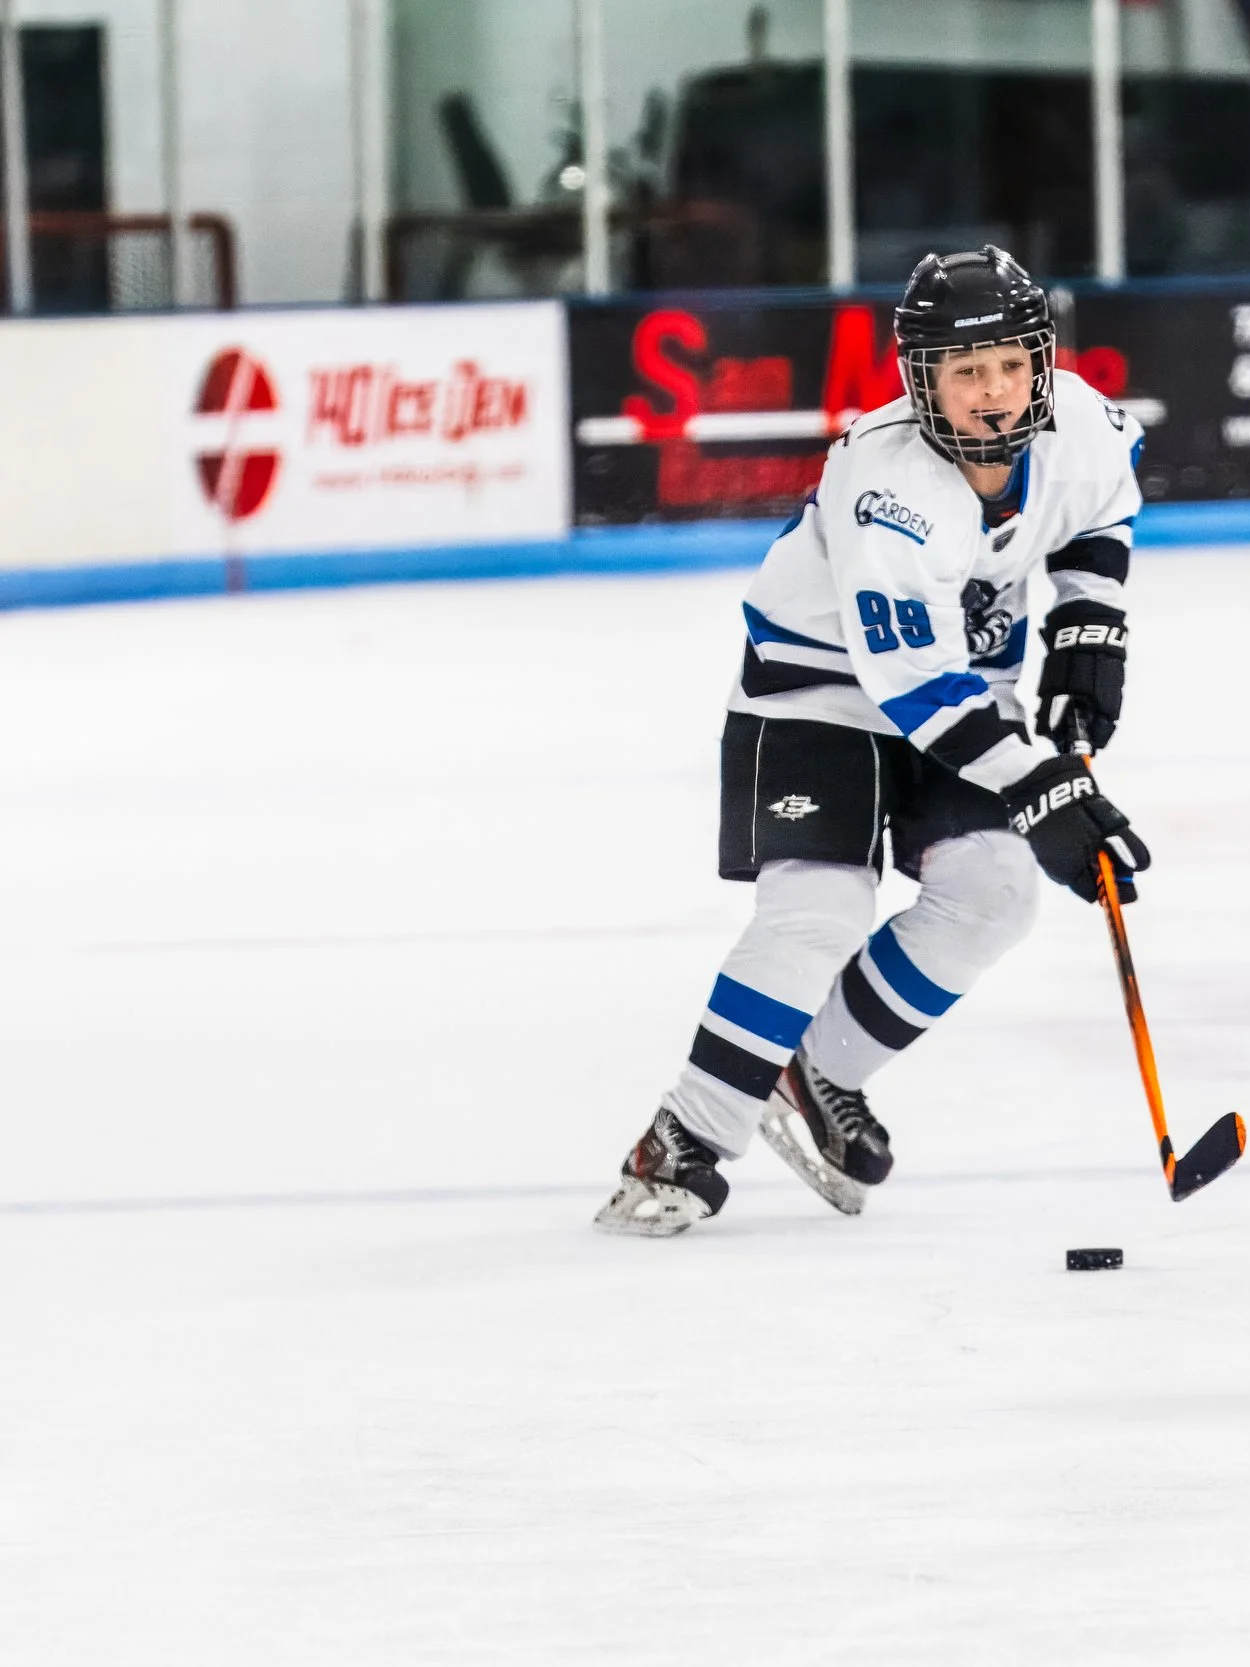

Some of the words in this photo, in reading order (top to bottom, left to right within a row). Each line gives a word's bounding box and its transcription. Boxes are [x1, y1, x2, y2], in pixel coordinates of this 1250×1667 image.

[856, 590, 936, 654] 99
[1054, 624, 1126, 650] BAU
[1009, 776, 1094, 835] AUER
